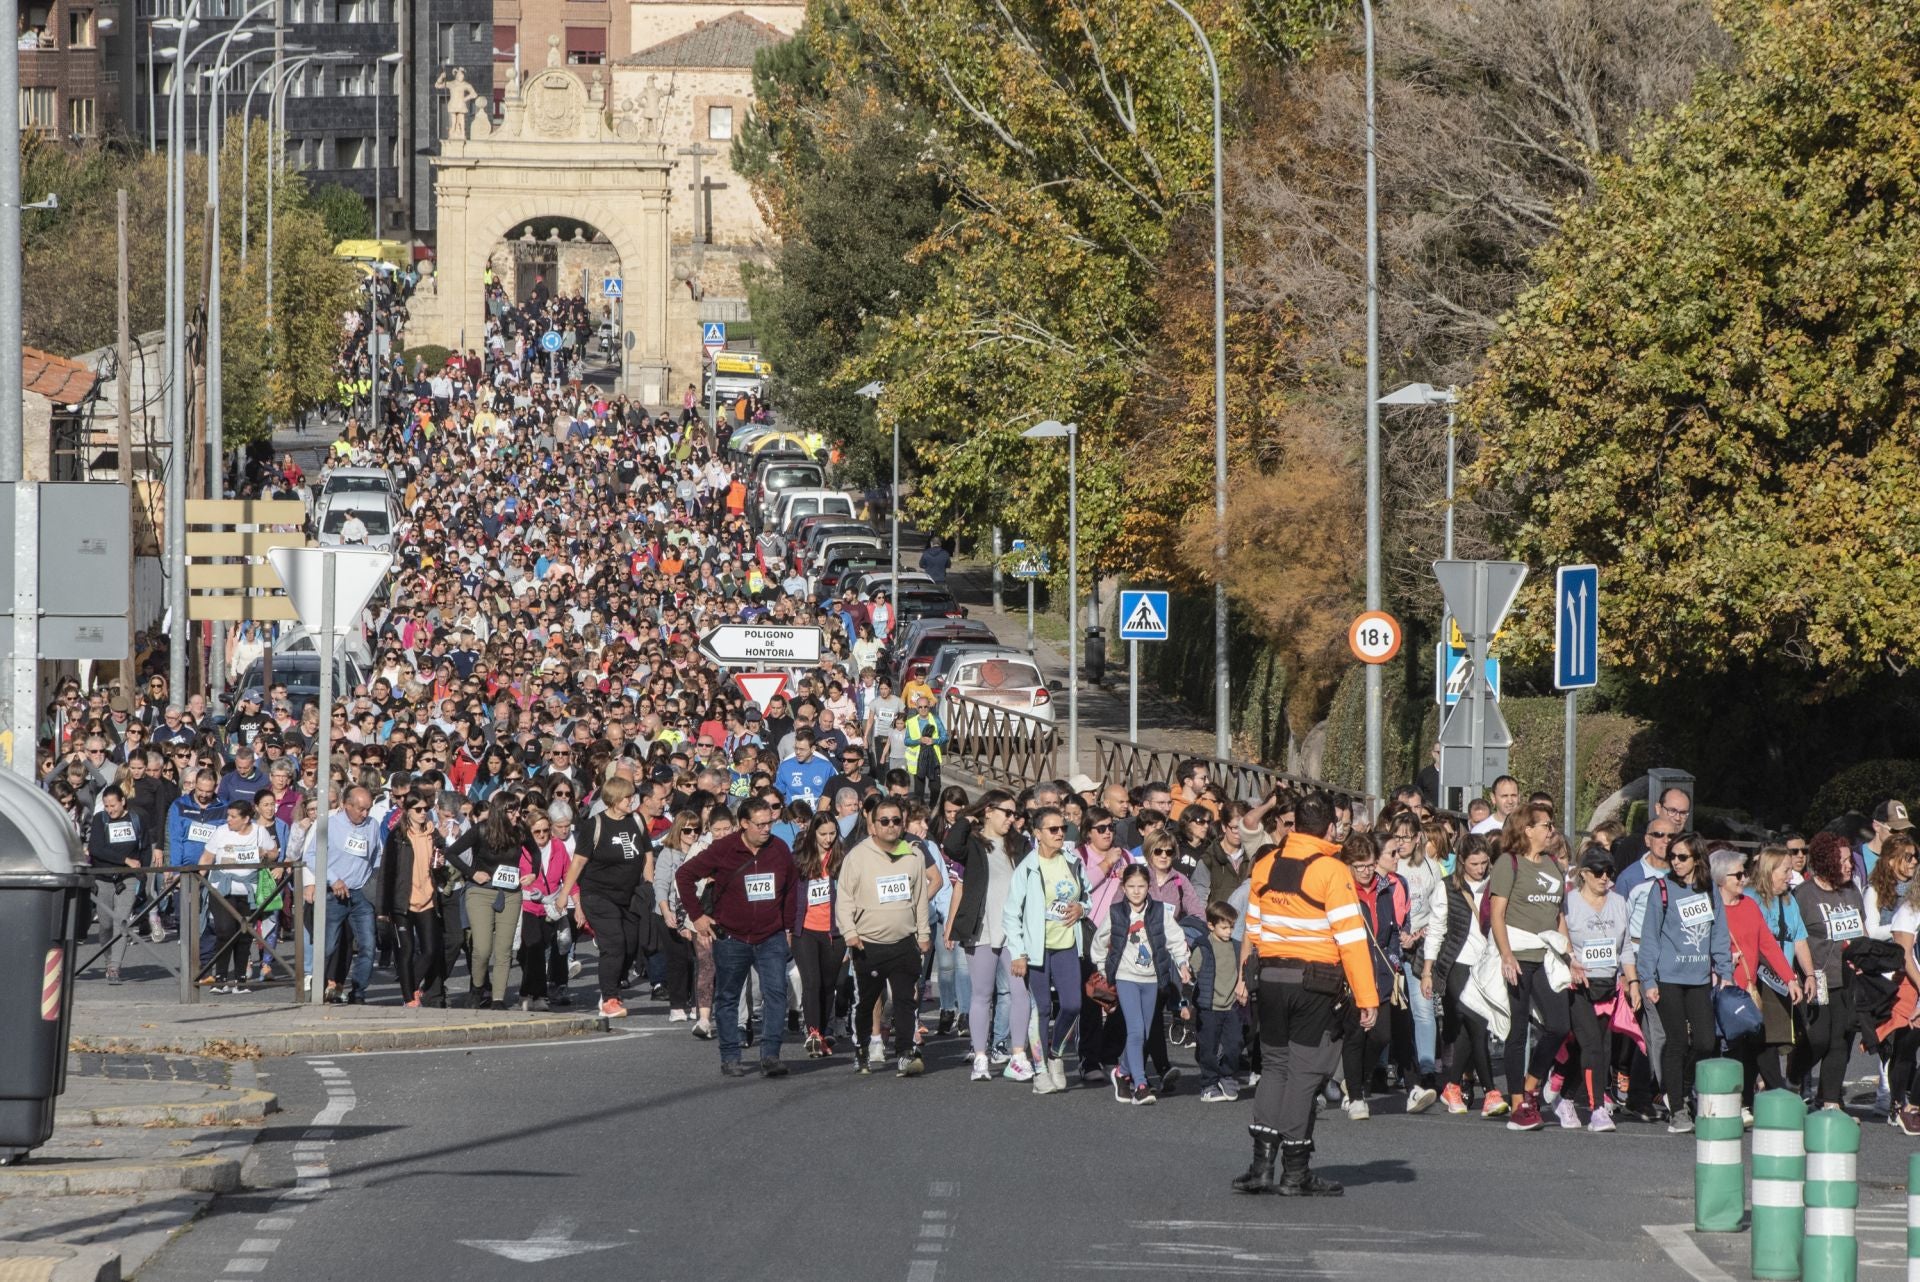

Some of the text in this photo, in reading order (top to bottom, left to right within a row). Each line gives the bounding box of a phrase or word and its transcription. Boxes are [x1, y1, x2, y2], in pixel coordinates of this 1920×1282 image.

[744, 630, 794, 639] POLIGONO
[1361, 629, 1389, 646] 18 t
[745, 648, 794, 657] HONTORIA
[192, 828, 212, 838] 6307
[497, 872, 515, 883] 2613
[747, 882, 771, 892] 7478
[881, 882, 906, 894] 7480
[1682, 902, 1708, 918] 6068
[1835, 918, 1860, 932] 6125
[1585, 947, 1612, 959] 6069
